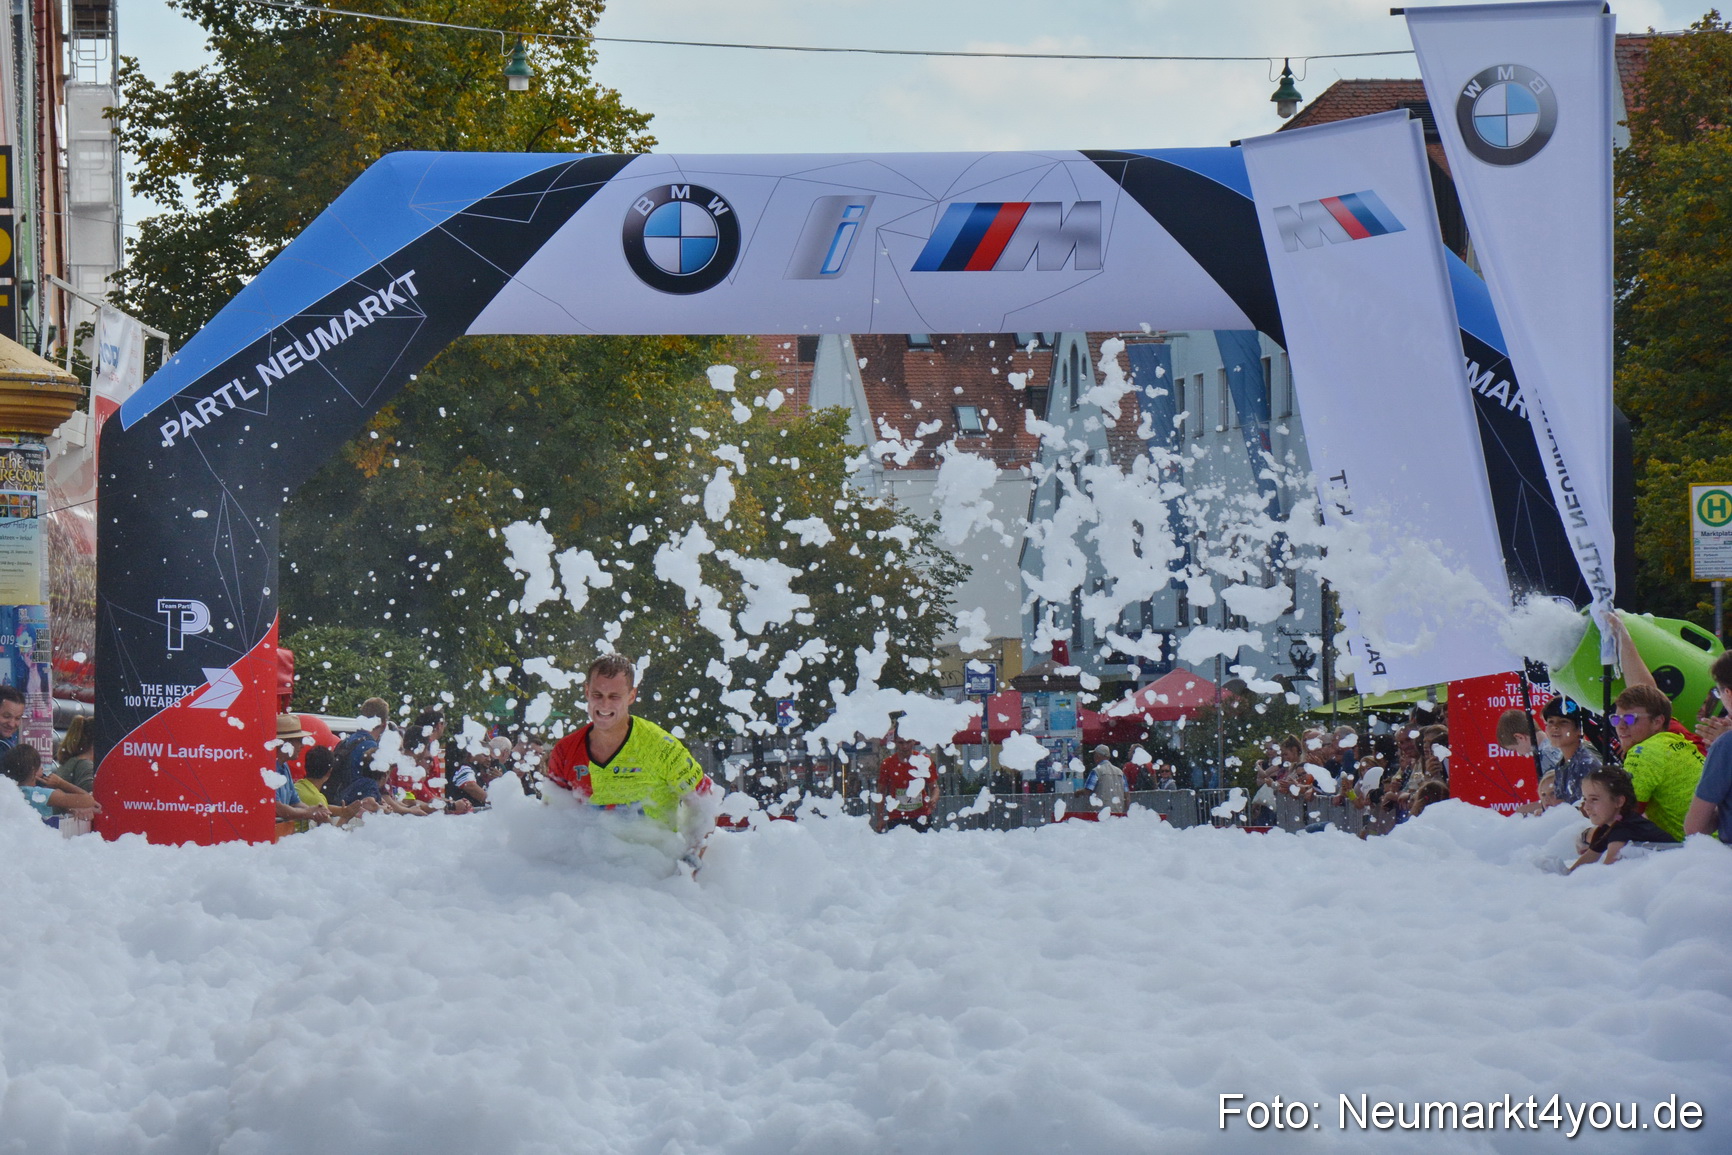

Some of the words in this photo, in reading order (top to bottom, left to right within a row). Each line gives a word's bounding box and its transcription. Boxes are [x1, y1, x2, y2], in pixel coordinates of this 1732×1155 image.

[632, 184, 730, 218] BMW
[990, 200, 1102, 272] M
[159, 377, 260, 448] PARTL
[255, 268, 420, 388] NEUMARKT
[0, 634, 15, 645] 019
[140, 683, 163, 696] THE
[165, 684, 197, 697] NEXT
[124, 695, 141, 707] 100
[143, 696, 182, 708] YEARS
[1487, 696, 1506, 707] 100
[123, 742, 163, 757] BMW
[167, 743, 245, 761] Laufsport
[123, 799, 245, 814] www.bmw-partl.de
